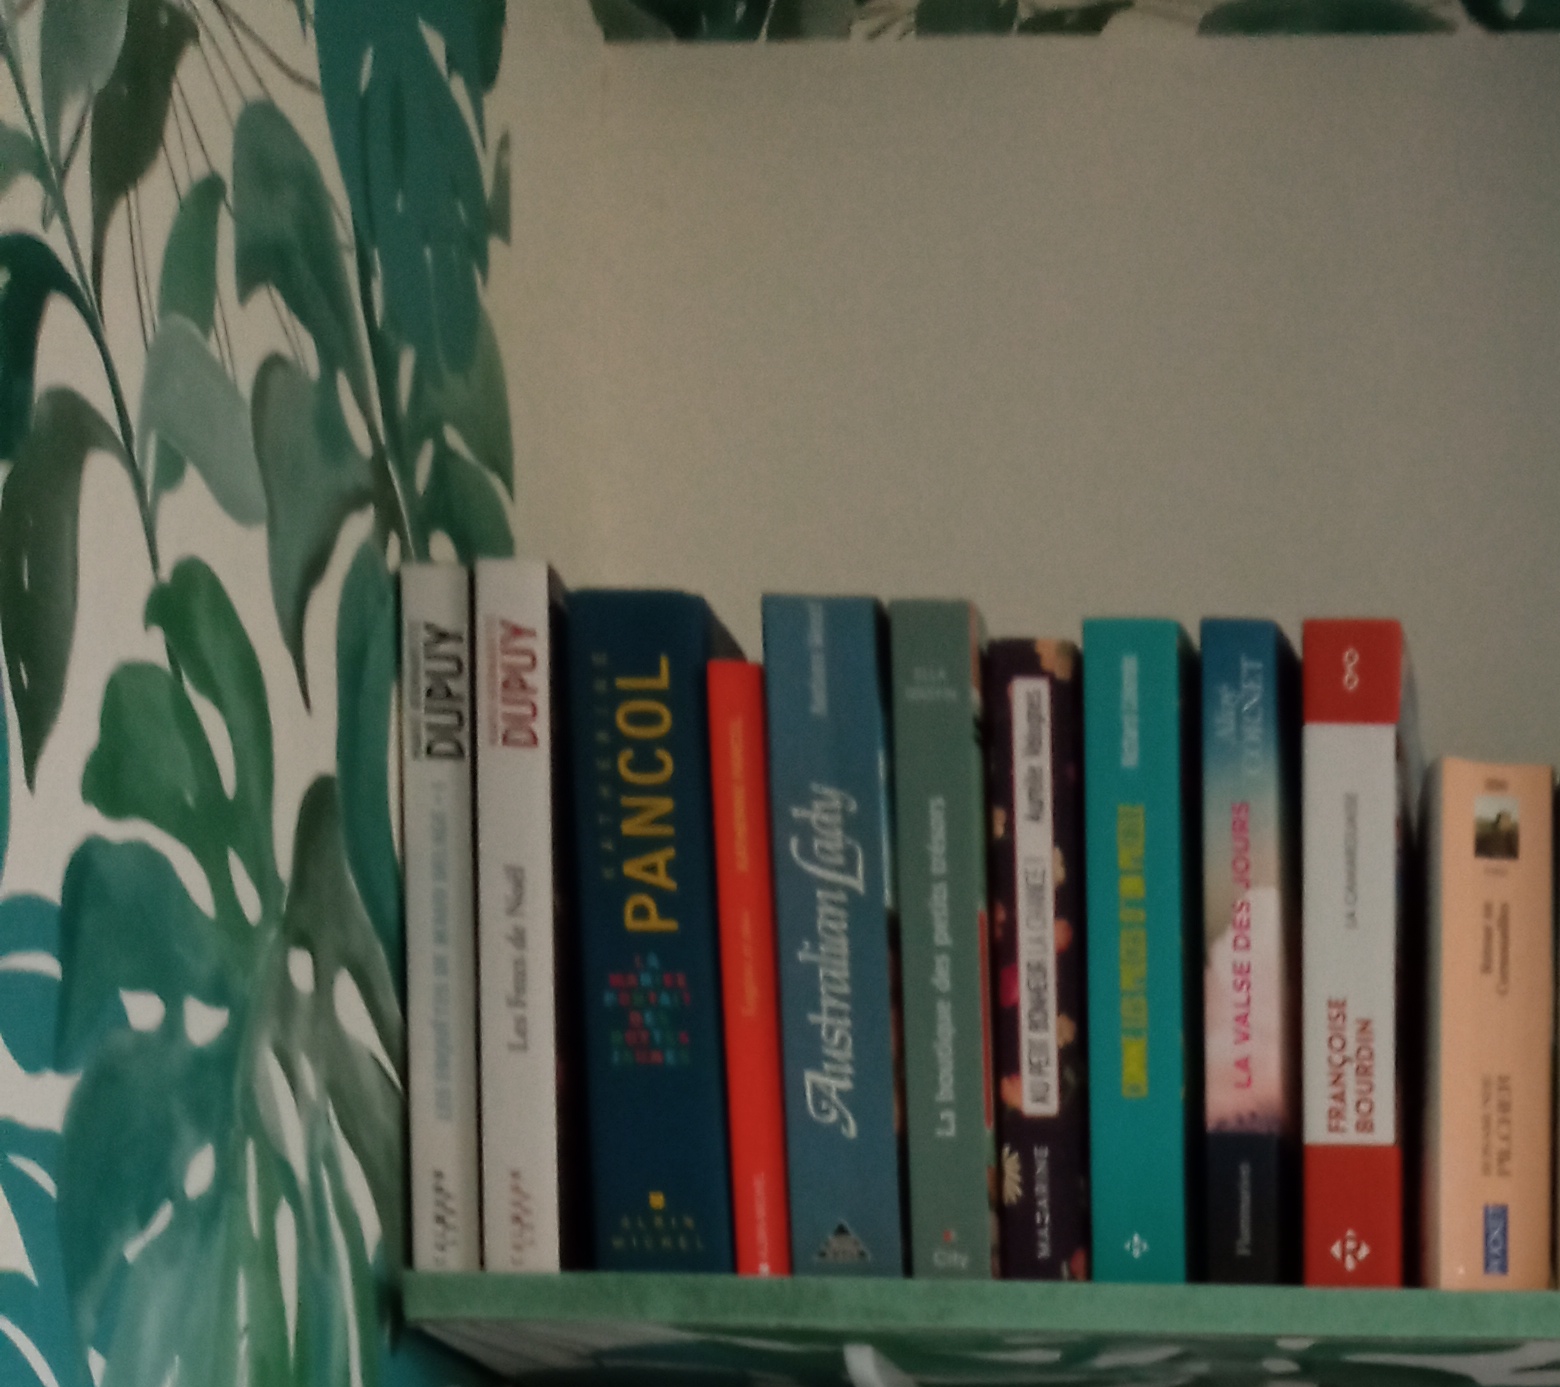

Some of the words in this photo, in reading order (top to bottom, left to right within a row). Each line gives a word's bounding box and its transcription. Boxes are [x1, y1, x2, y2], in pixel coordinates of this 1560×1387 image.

[422, 620, 466, 761] DUPUY
[498, 618, 539, 749] DUPUY
[615, 653, 679, 933] PANCOL
[788, 780, 867, 896] Lady
[1231, 801, 1252, 890] JOURS
[929, 879, 954, 947] petits
[1232, 899, 1252, 952] DES
[796, 888, 860, 1141] Australian
[931, 952, 954, 998] des
[1232, 960, 1252, 1046] VALSE
[932, 1001, 958, 1102] boutique
[1232, 1057, 1253, 1090] LA
[1325, 995, 1354, 1134] FRANÇOISE
[1354, 1016, 1375, 1134] BOURDIN
[934, 1109, 958, 1138] La
[1496, 1075, 1513, 1177] PILCHER
[1034, 1145, 1052, 1259] MAZARINE
